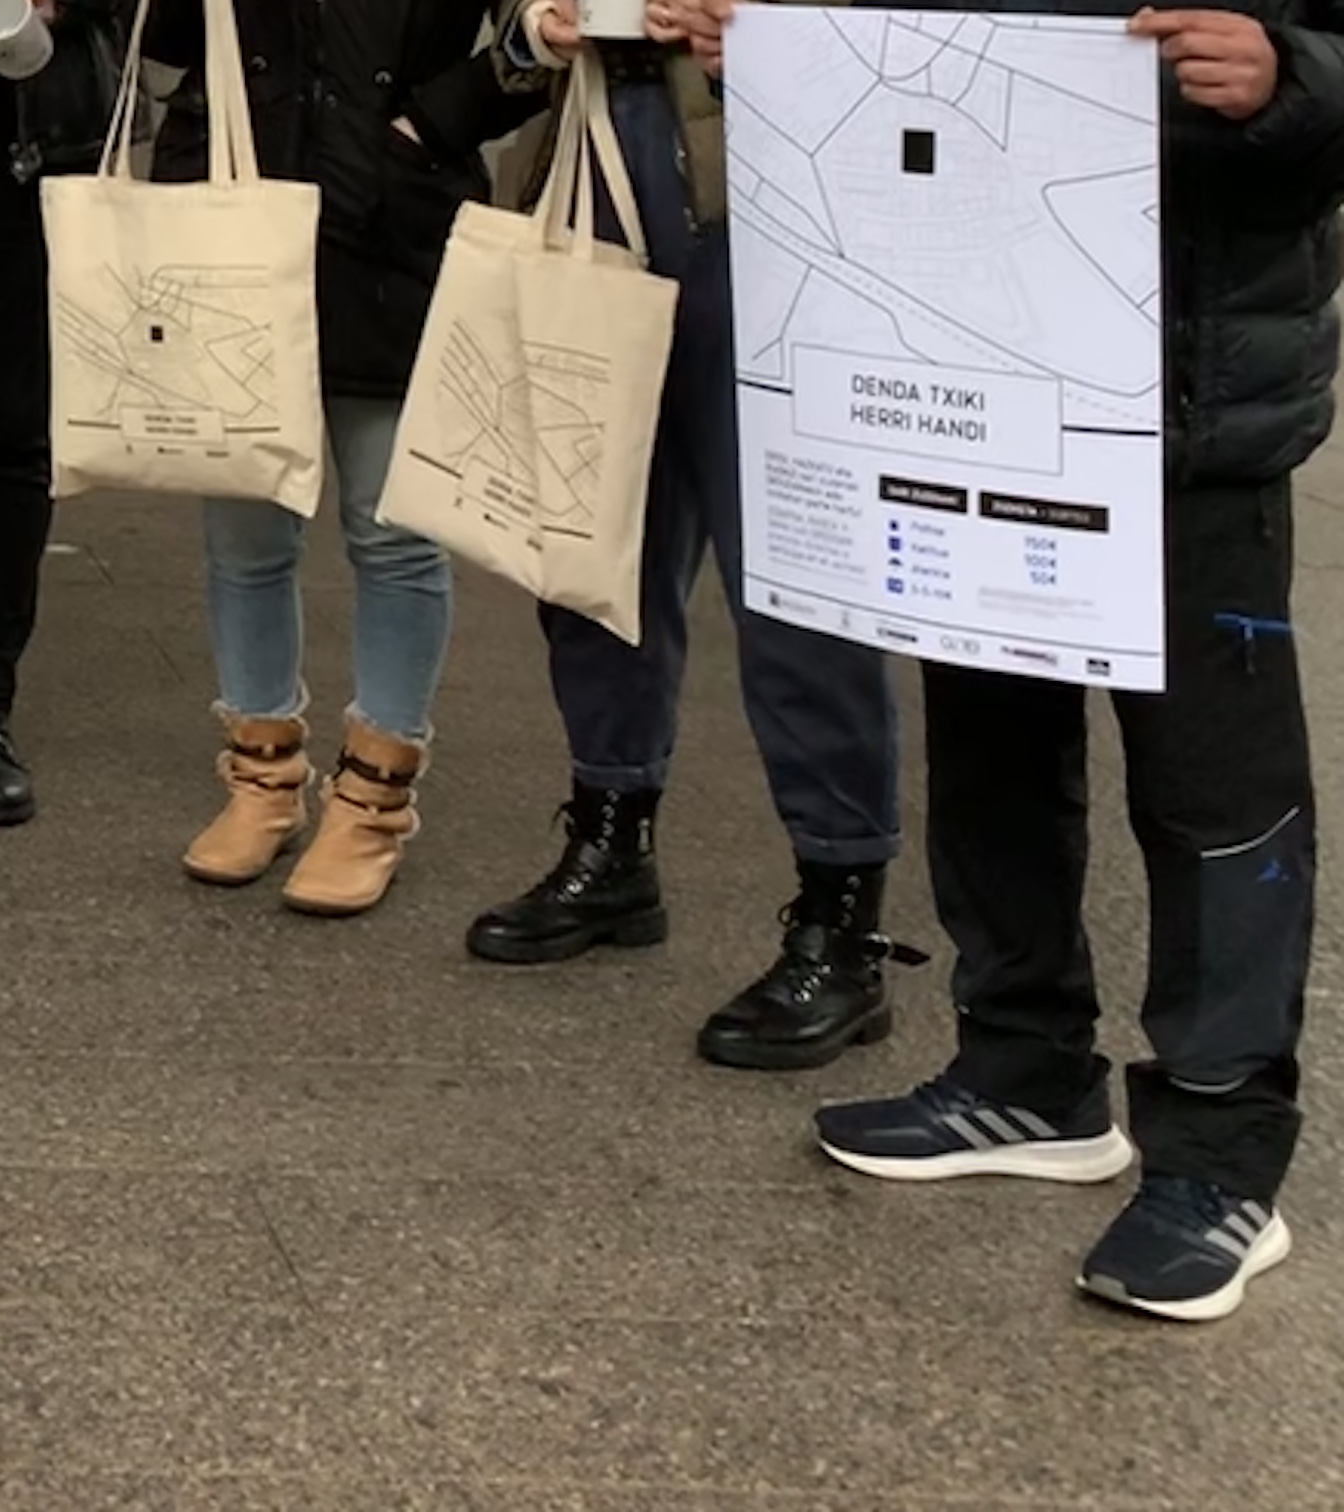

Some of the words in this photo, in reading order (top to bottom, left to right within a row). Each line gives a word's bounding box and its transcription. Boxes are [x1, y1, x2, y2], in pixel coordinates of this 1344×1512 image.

[851, 373, 921, 403] DENDA
[929, 383, 985, 412] TXIKI
[850, 403, 912, 432] HERRI
[917, 414, 987, 443] HANDI
